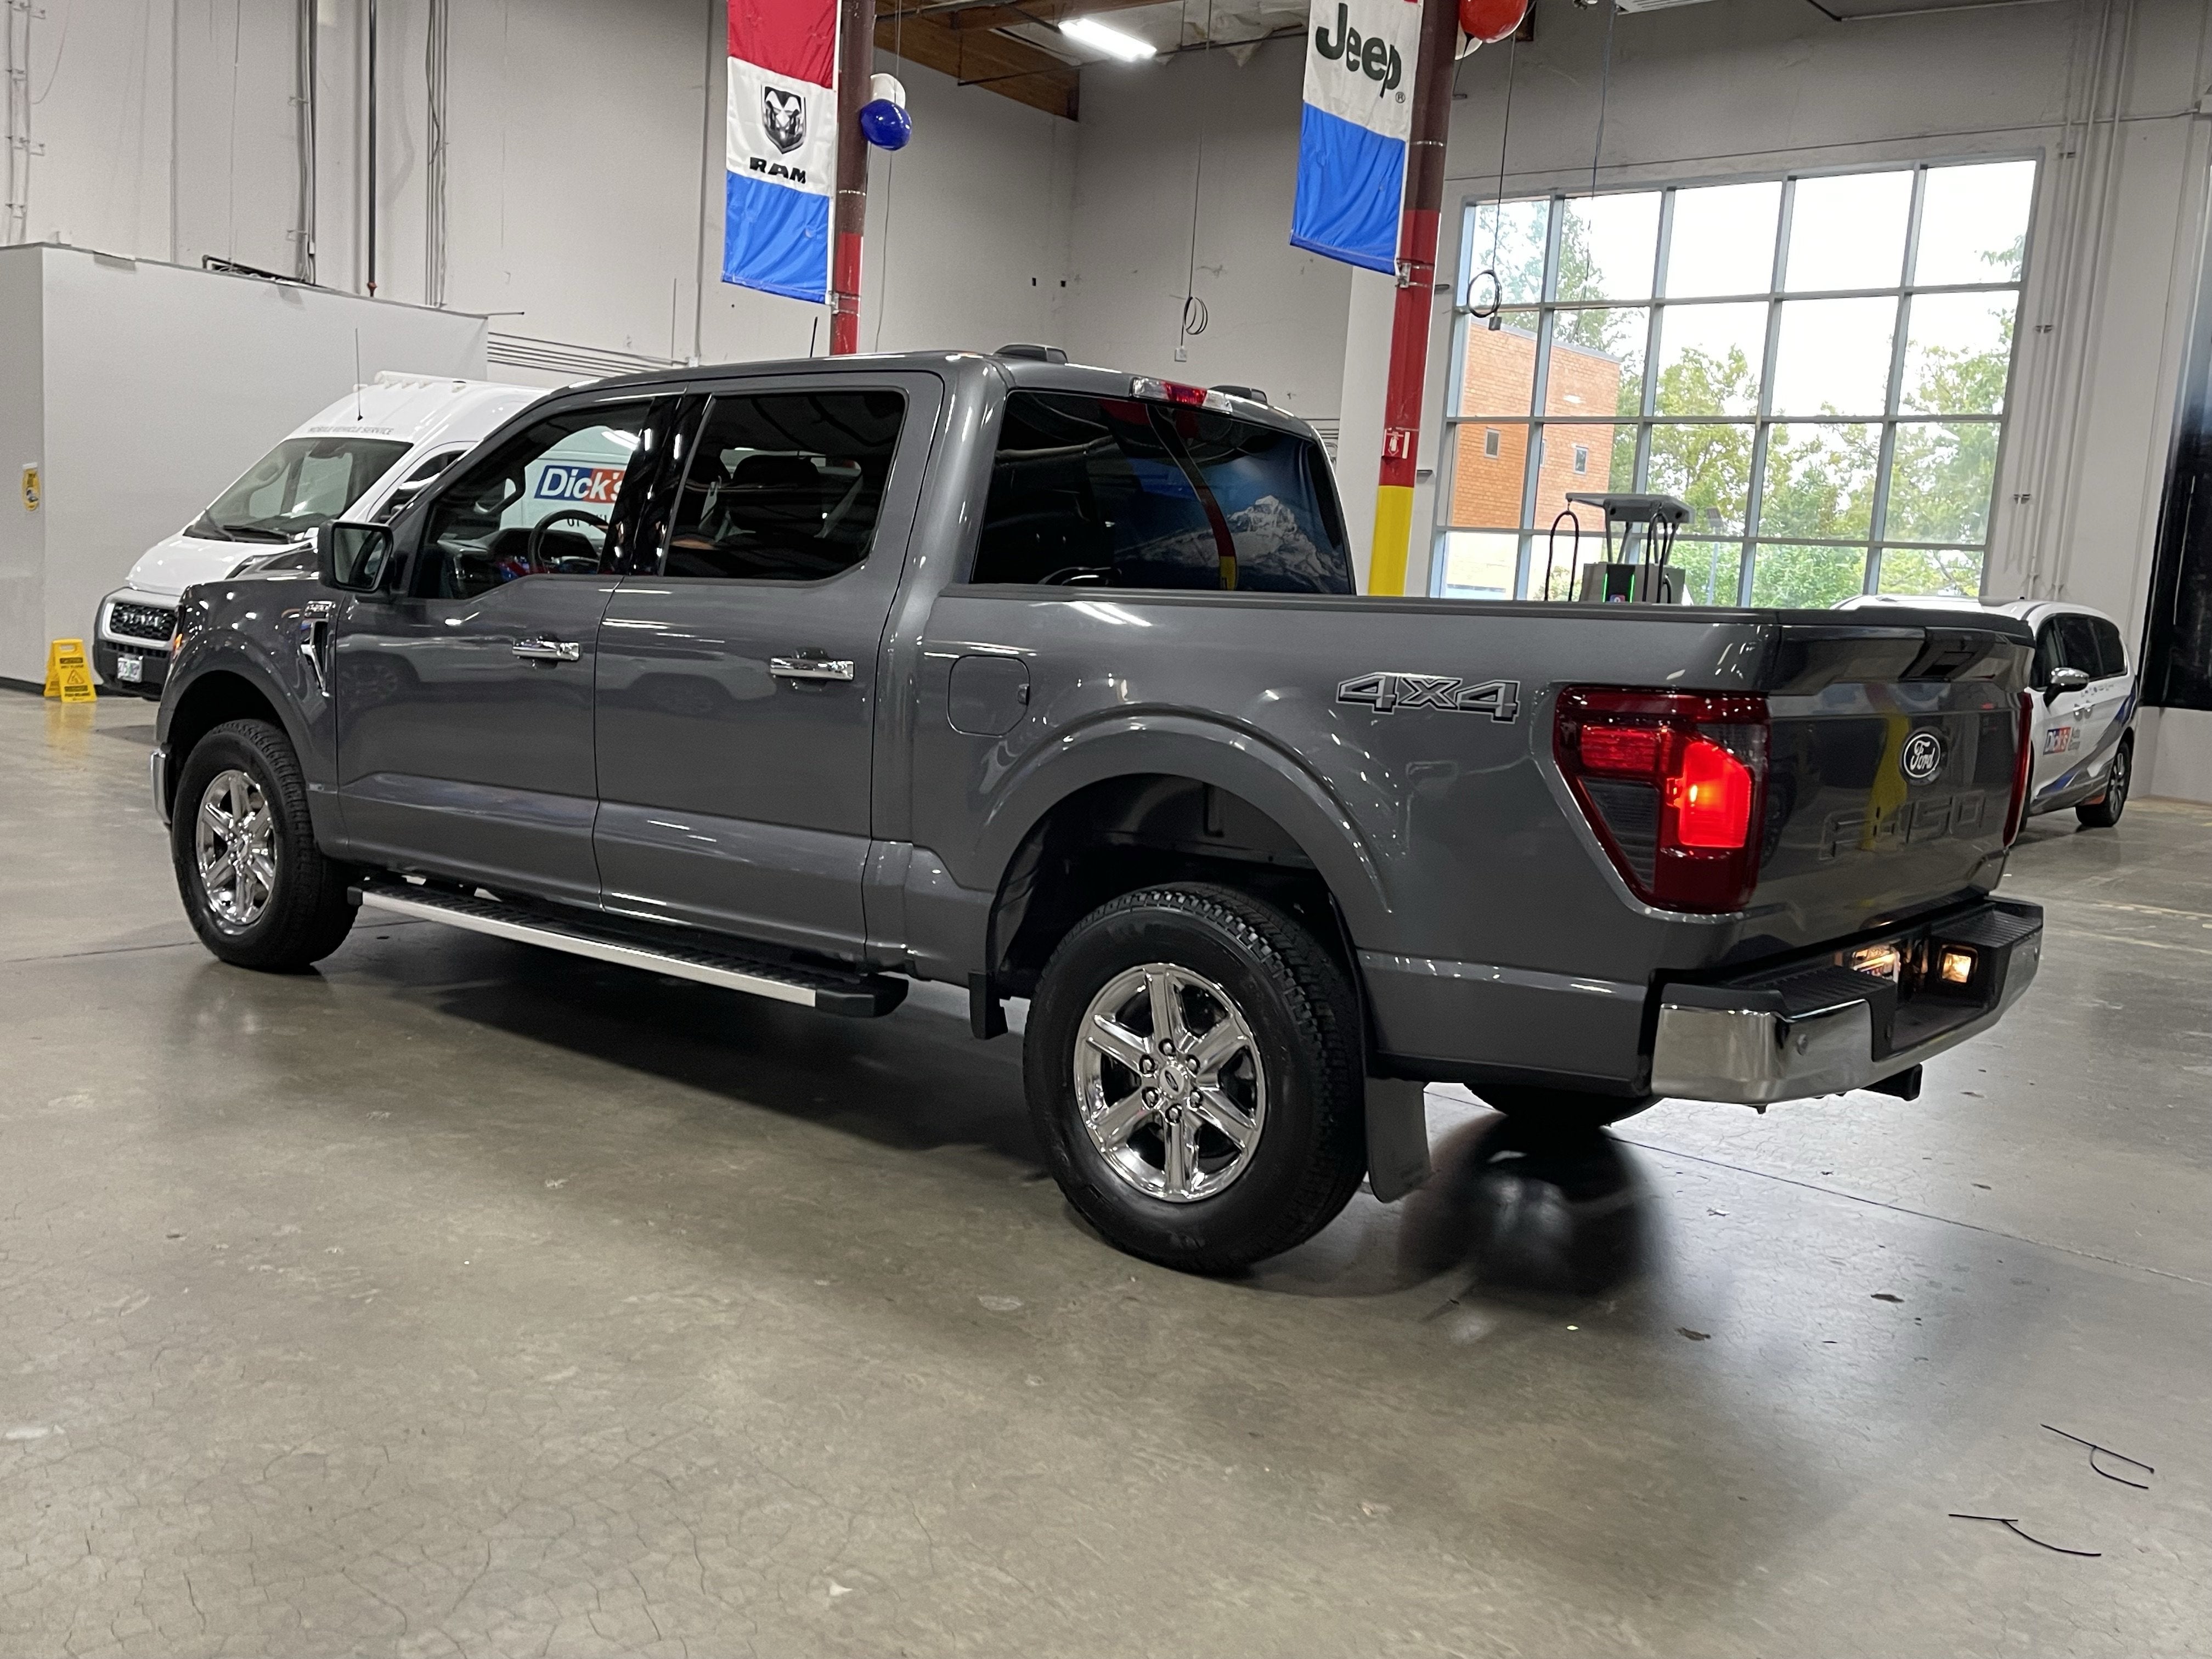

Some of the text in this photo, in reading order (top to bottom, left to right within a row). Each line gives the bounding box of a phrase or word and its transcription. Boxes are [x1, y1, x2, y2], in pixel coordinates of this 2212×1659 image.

[1316, 3, 1402, 98] Jeep
[749, 157, 806, 184] RAM
[1910, 740, 1936, 770] Ford
[1819, 790, 1986, 860] F-150
